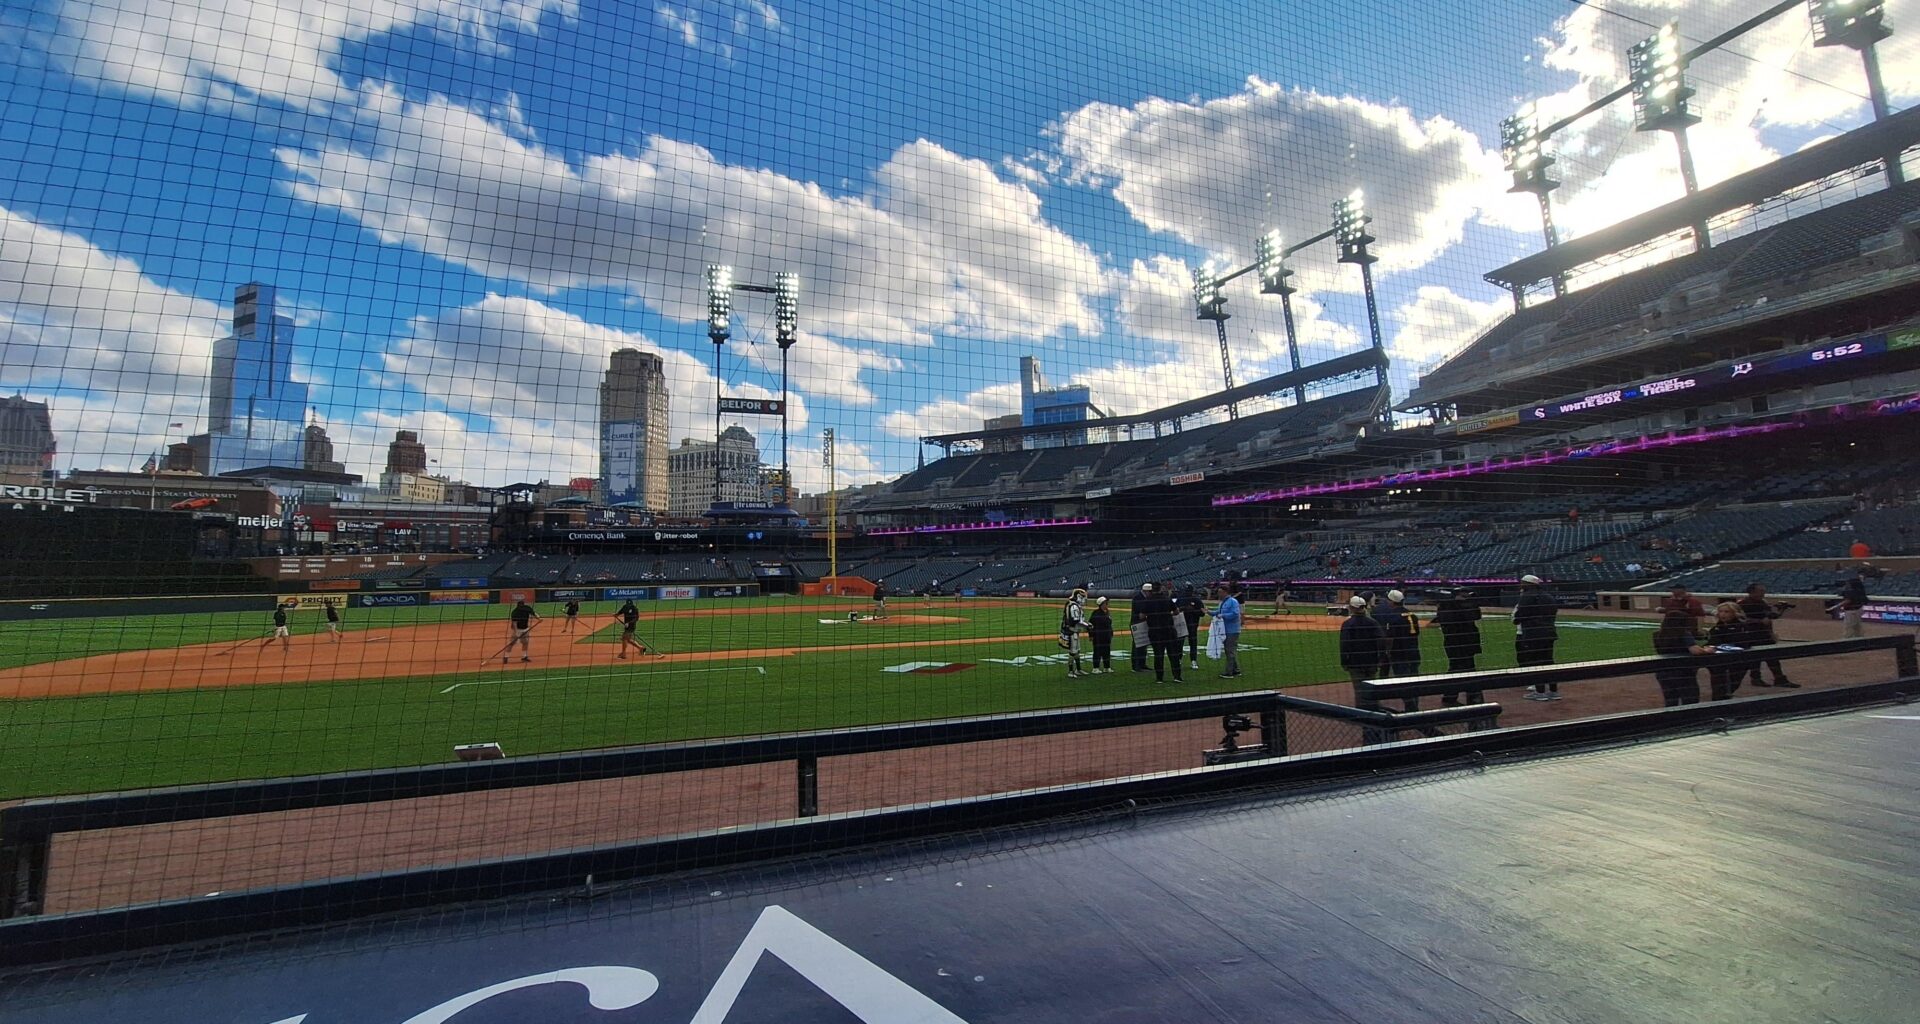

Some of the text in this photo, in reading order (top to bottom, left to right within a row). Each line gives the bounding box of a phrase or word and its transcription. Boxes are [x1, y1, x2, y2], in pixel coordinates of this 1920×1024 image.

[1812, 344, 1862, 361] 5:52
[1640, 378, 1679, 392] DETROIT
[1643, 379, 1696, 396] TIGERS
[1585, 391, 1621, 402] CHICAGO
[721, 400, 762, 410] BELFOR
[1560, 394, 1622, 413] WHITE SOX
[1171, 473, 1203, 484] TOSHIBA
[237, 514, 284, 530] meijer
[394, 528, 412, 536] LAW
[375, 594, 416, 603] VANDA
[618, 589, 643, 597] McLaren
[665, 590, 691, 598] meijer
